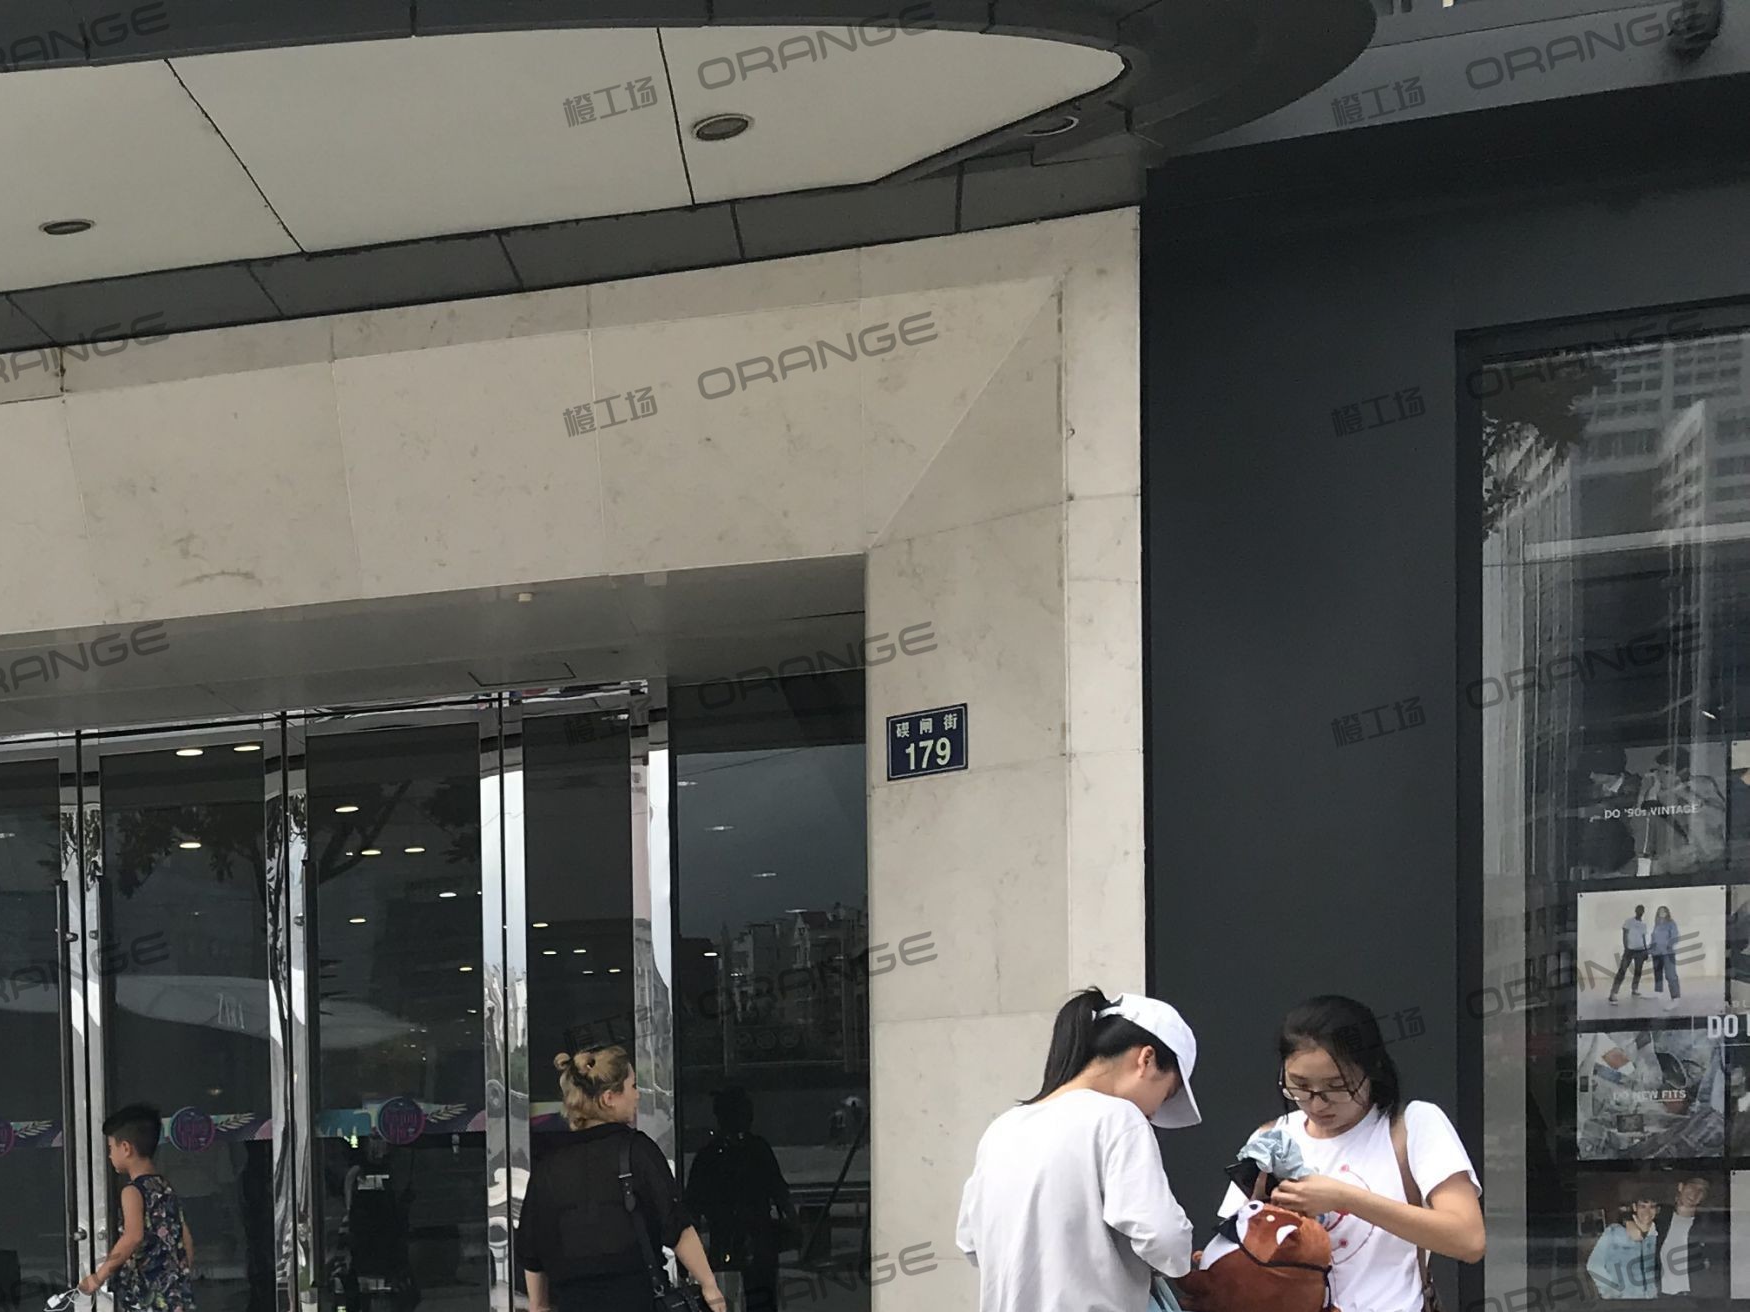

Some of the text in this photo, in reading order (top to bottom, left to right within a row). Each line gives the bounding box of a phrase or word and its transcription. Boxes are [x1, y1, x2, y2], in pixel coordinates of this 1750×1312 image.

[905, 736, 952, 770] 179
[1650, 803, 1699, 816] VINTAGE
[1661, 1089, 1687, 1099] FITS
